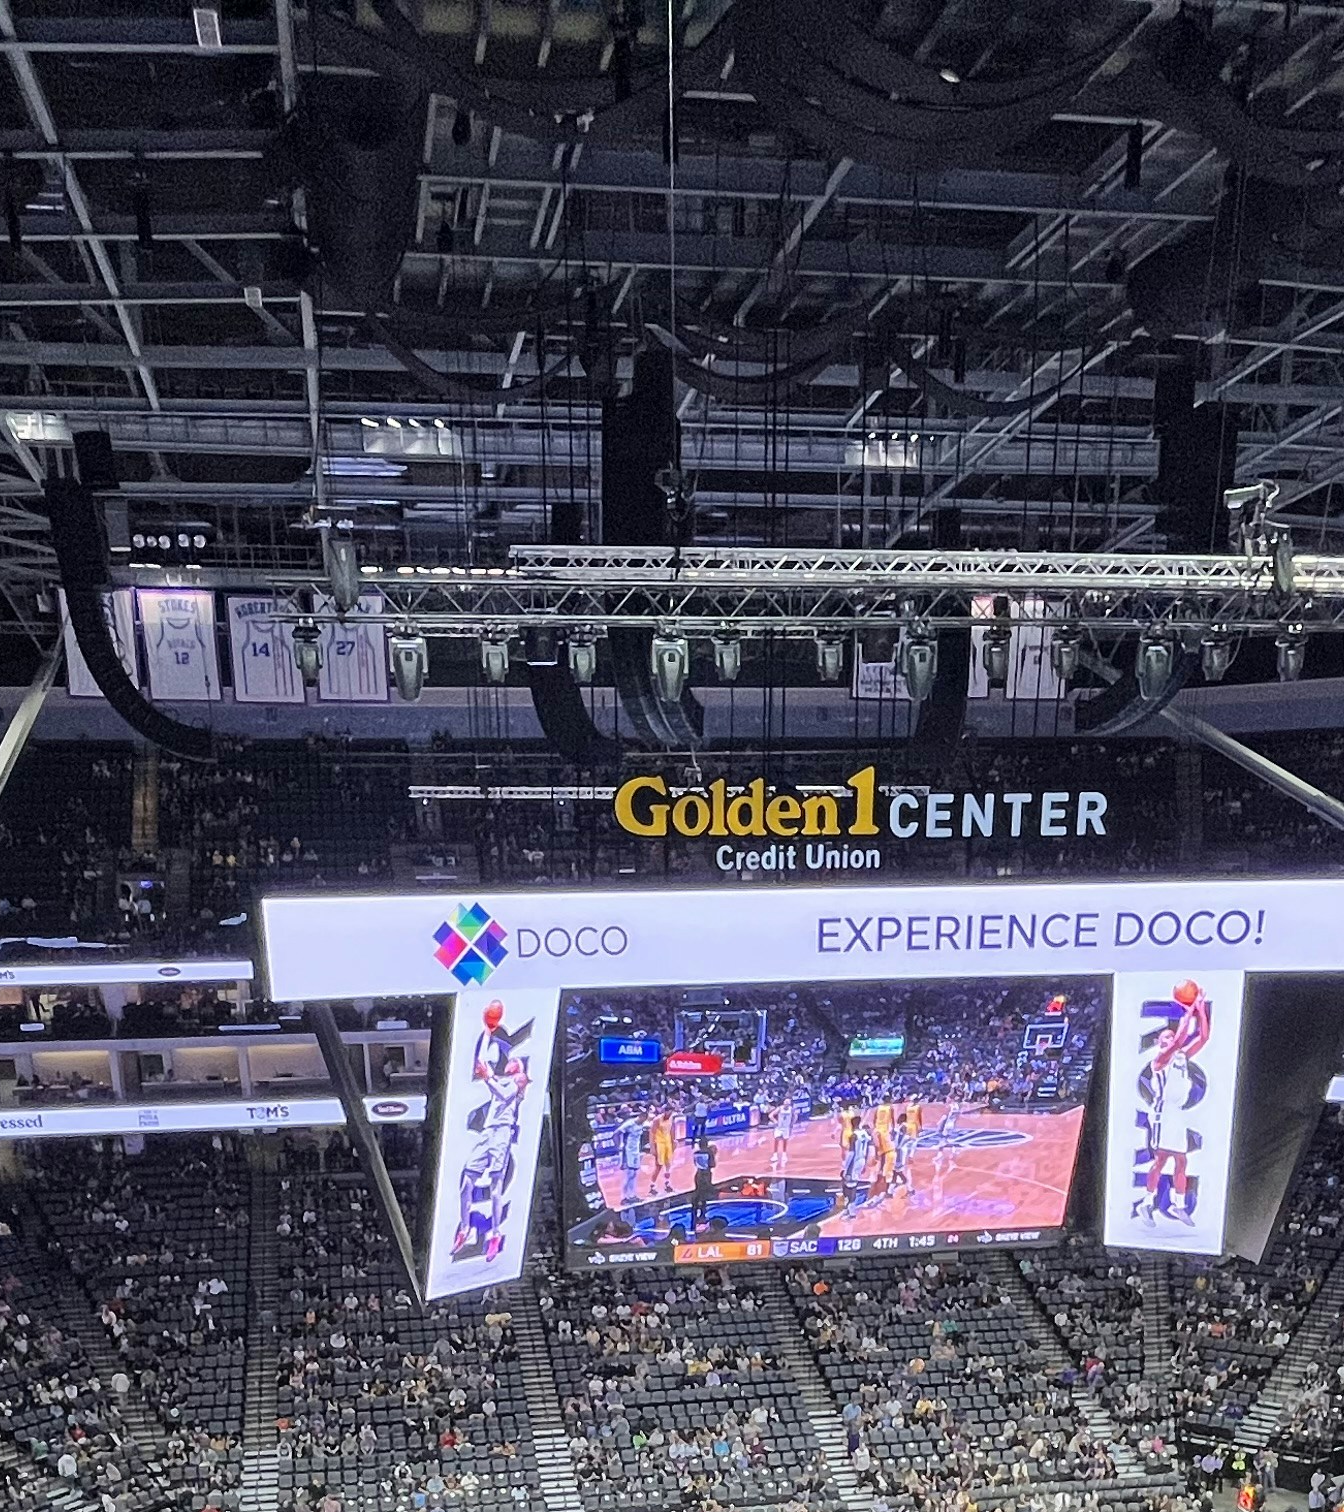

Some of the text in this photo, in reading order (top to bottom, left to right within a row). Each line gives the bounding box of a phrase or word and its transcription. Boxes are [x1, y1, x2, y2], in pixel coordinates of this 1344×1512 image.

[174, 652, 190, 665] 12
[251, 642, 271, 658] 14
[336, 641, 355, 657] 27
[889, 790, 1108, 839] CENTER
[716, 844, 880, 871] Credit Union
[516, 926, 628, 958] DOCO
[817, 908, 1267, 954] EXPERIENCE DOCO!
[697, 1246, 723, 1258] LAL
[746, 1244, 763, 1256] 81
[790, 1240, 818, 1253] SAC
[872, 1236, 899, 1249] 4TH
[908, 1235, 936, 1247] 1:45
